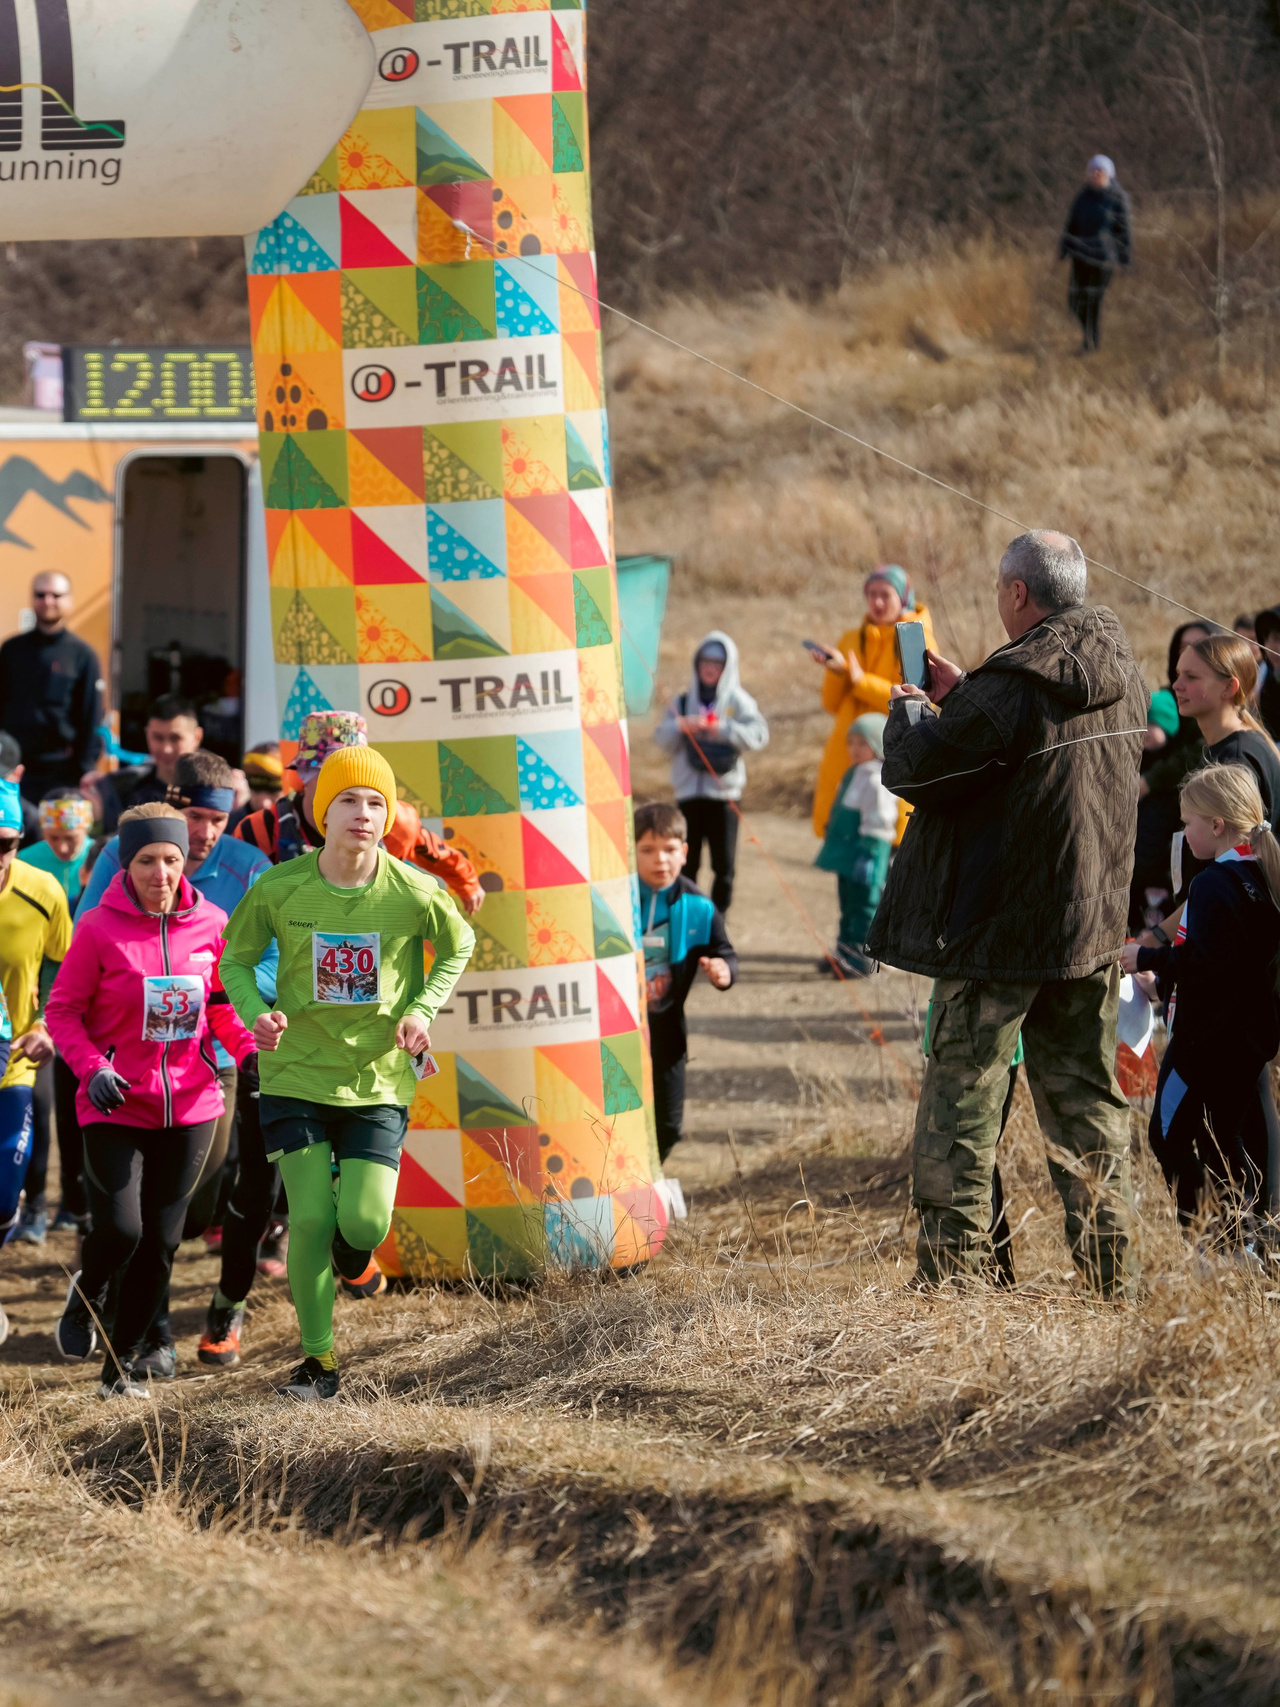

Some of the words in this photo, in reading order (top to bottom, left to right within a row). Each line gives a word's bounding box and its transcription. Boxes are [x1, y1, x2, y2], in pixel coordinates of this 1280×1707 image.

[320, 947, 375, 975] 430
[160, 991, 189, 1016] 53
[13, 1114, 33, 1165] CRAFT
